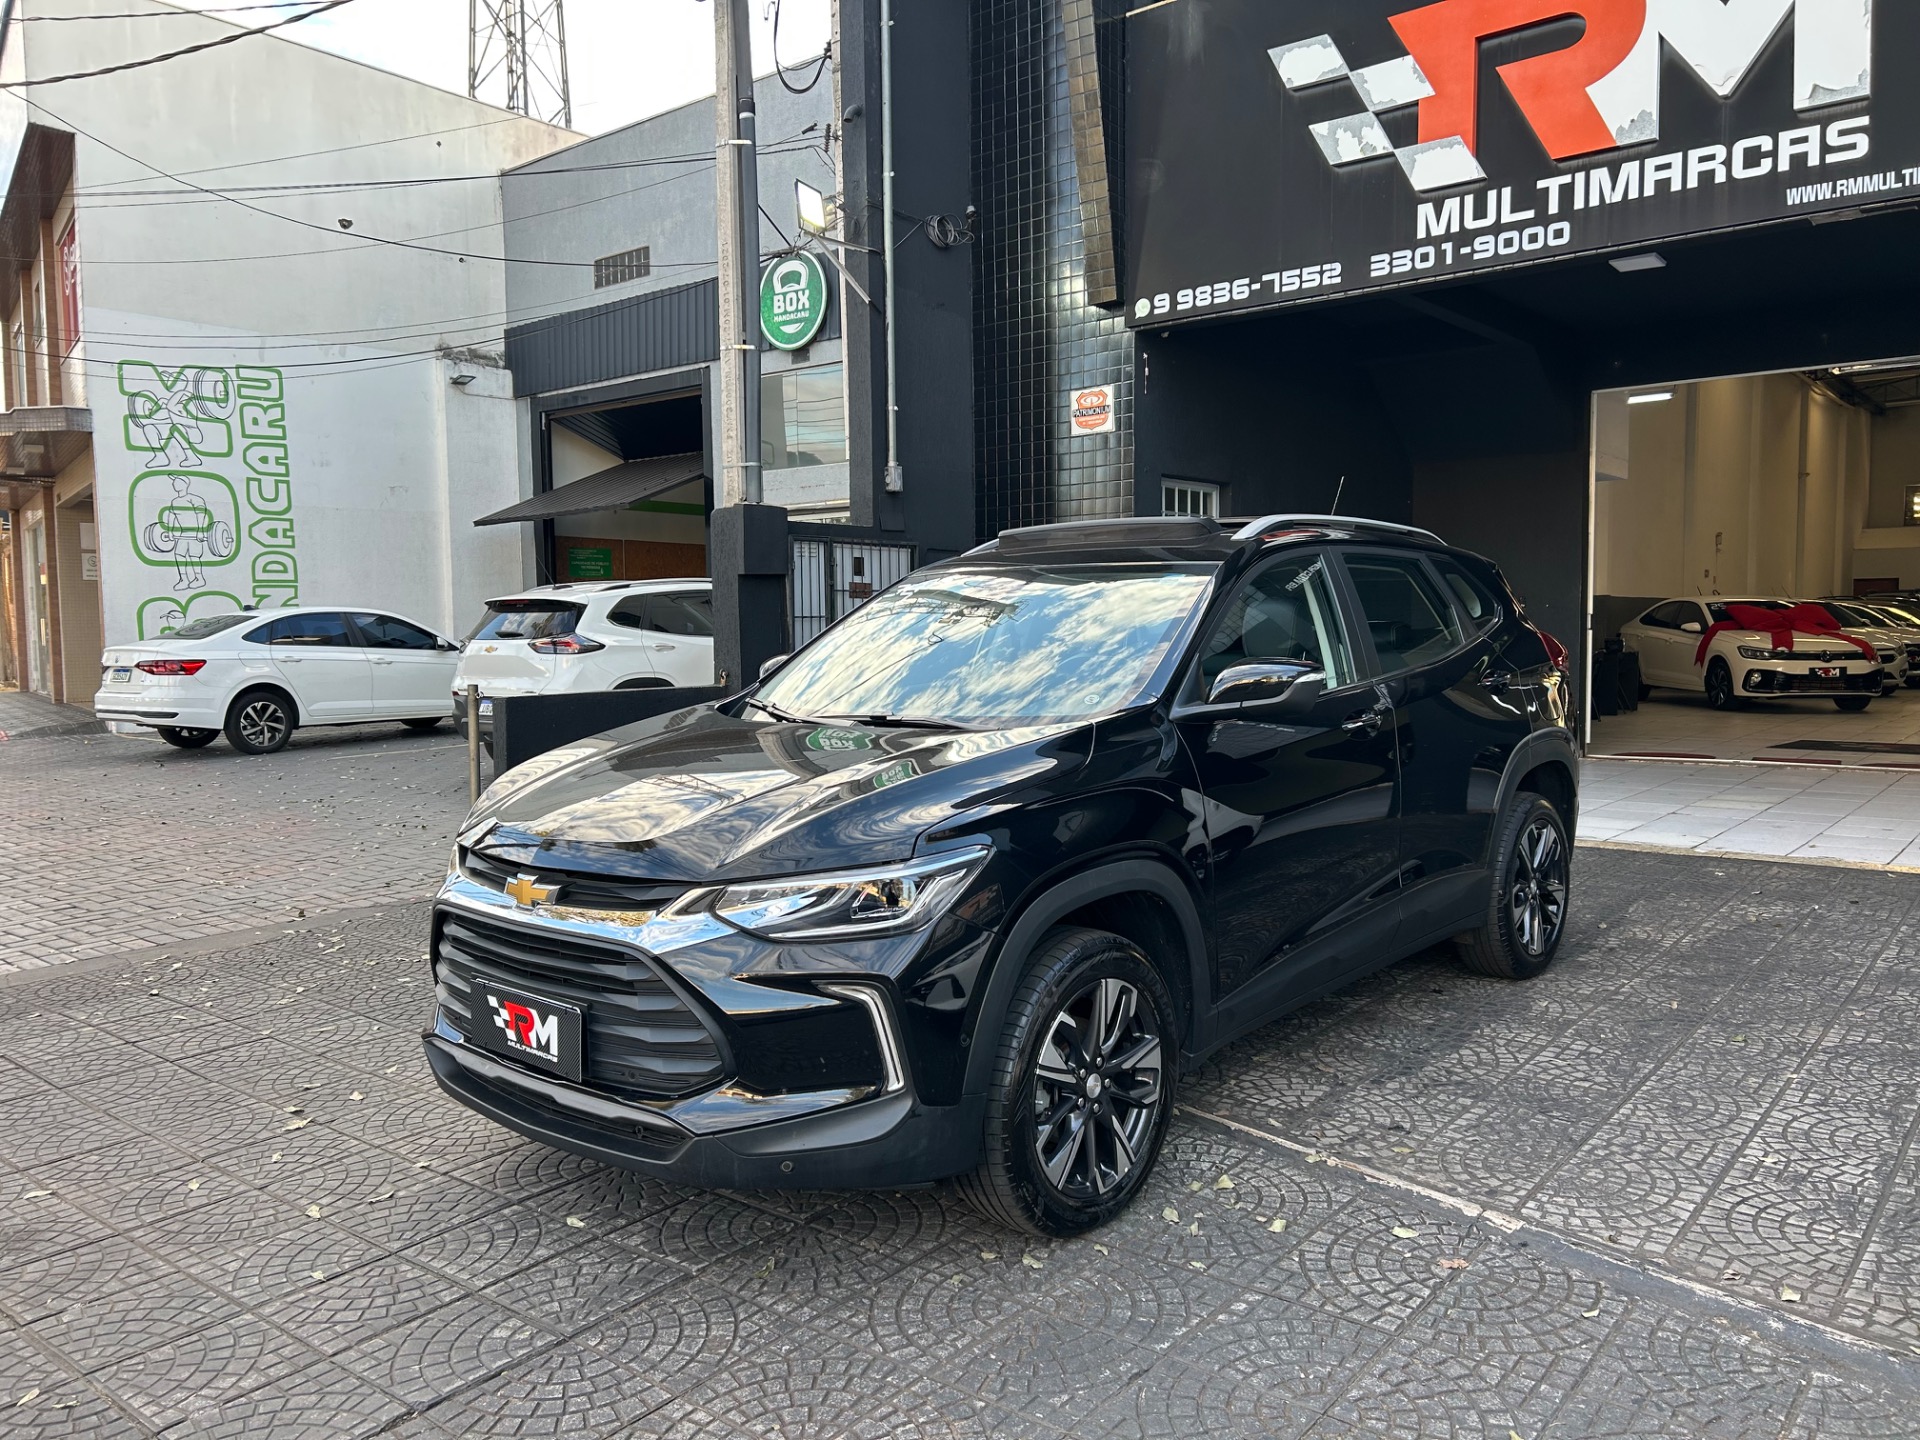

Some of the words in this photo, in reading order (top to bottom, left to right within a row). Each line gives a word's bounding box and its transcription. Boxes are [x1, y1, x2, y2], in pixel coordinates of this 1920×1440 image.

[1416, 115, 1869, 240] MULTIMARCAS
[1786, 166, 1920, 206] WWW.RMMULTI
[1370, 221, 1571, 278] 3301-9000
[773, 289, 809, 313] BOX
[1153, 292, 1170, 315] 9
[1176, 262, 1342, 311] 9836-7552
[773, 310, 810, 322] MANDACARU
[235, 363, 299, 608] NDACARU
[504, 1000, 558, 1056] RM
[507, 1040, 558, 1063] MULTIMARCAS
